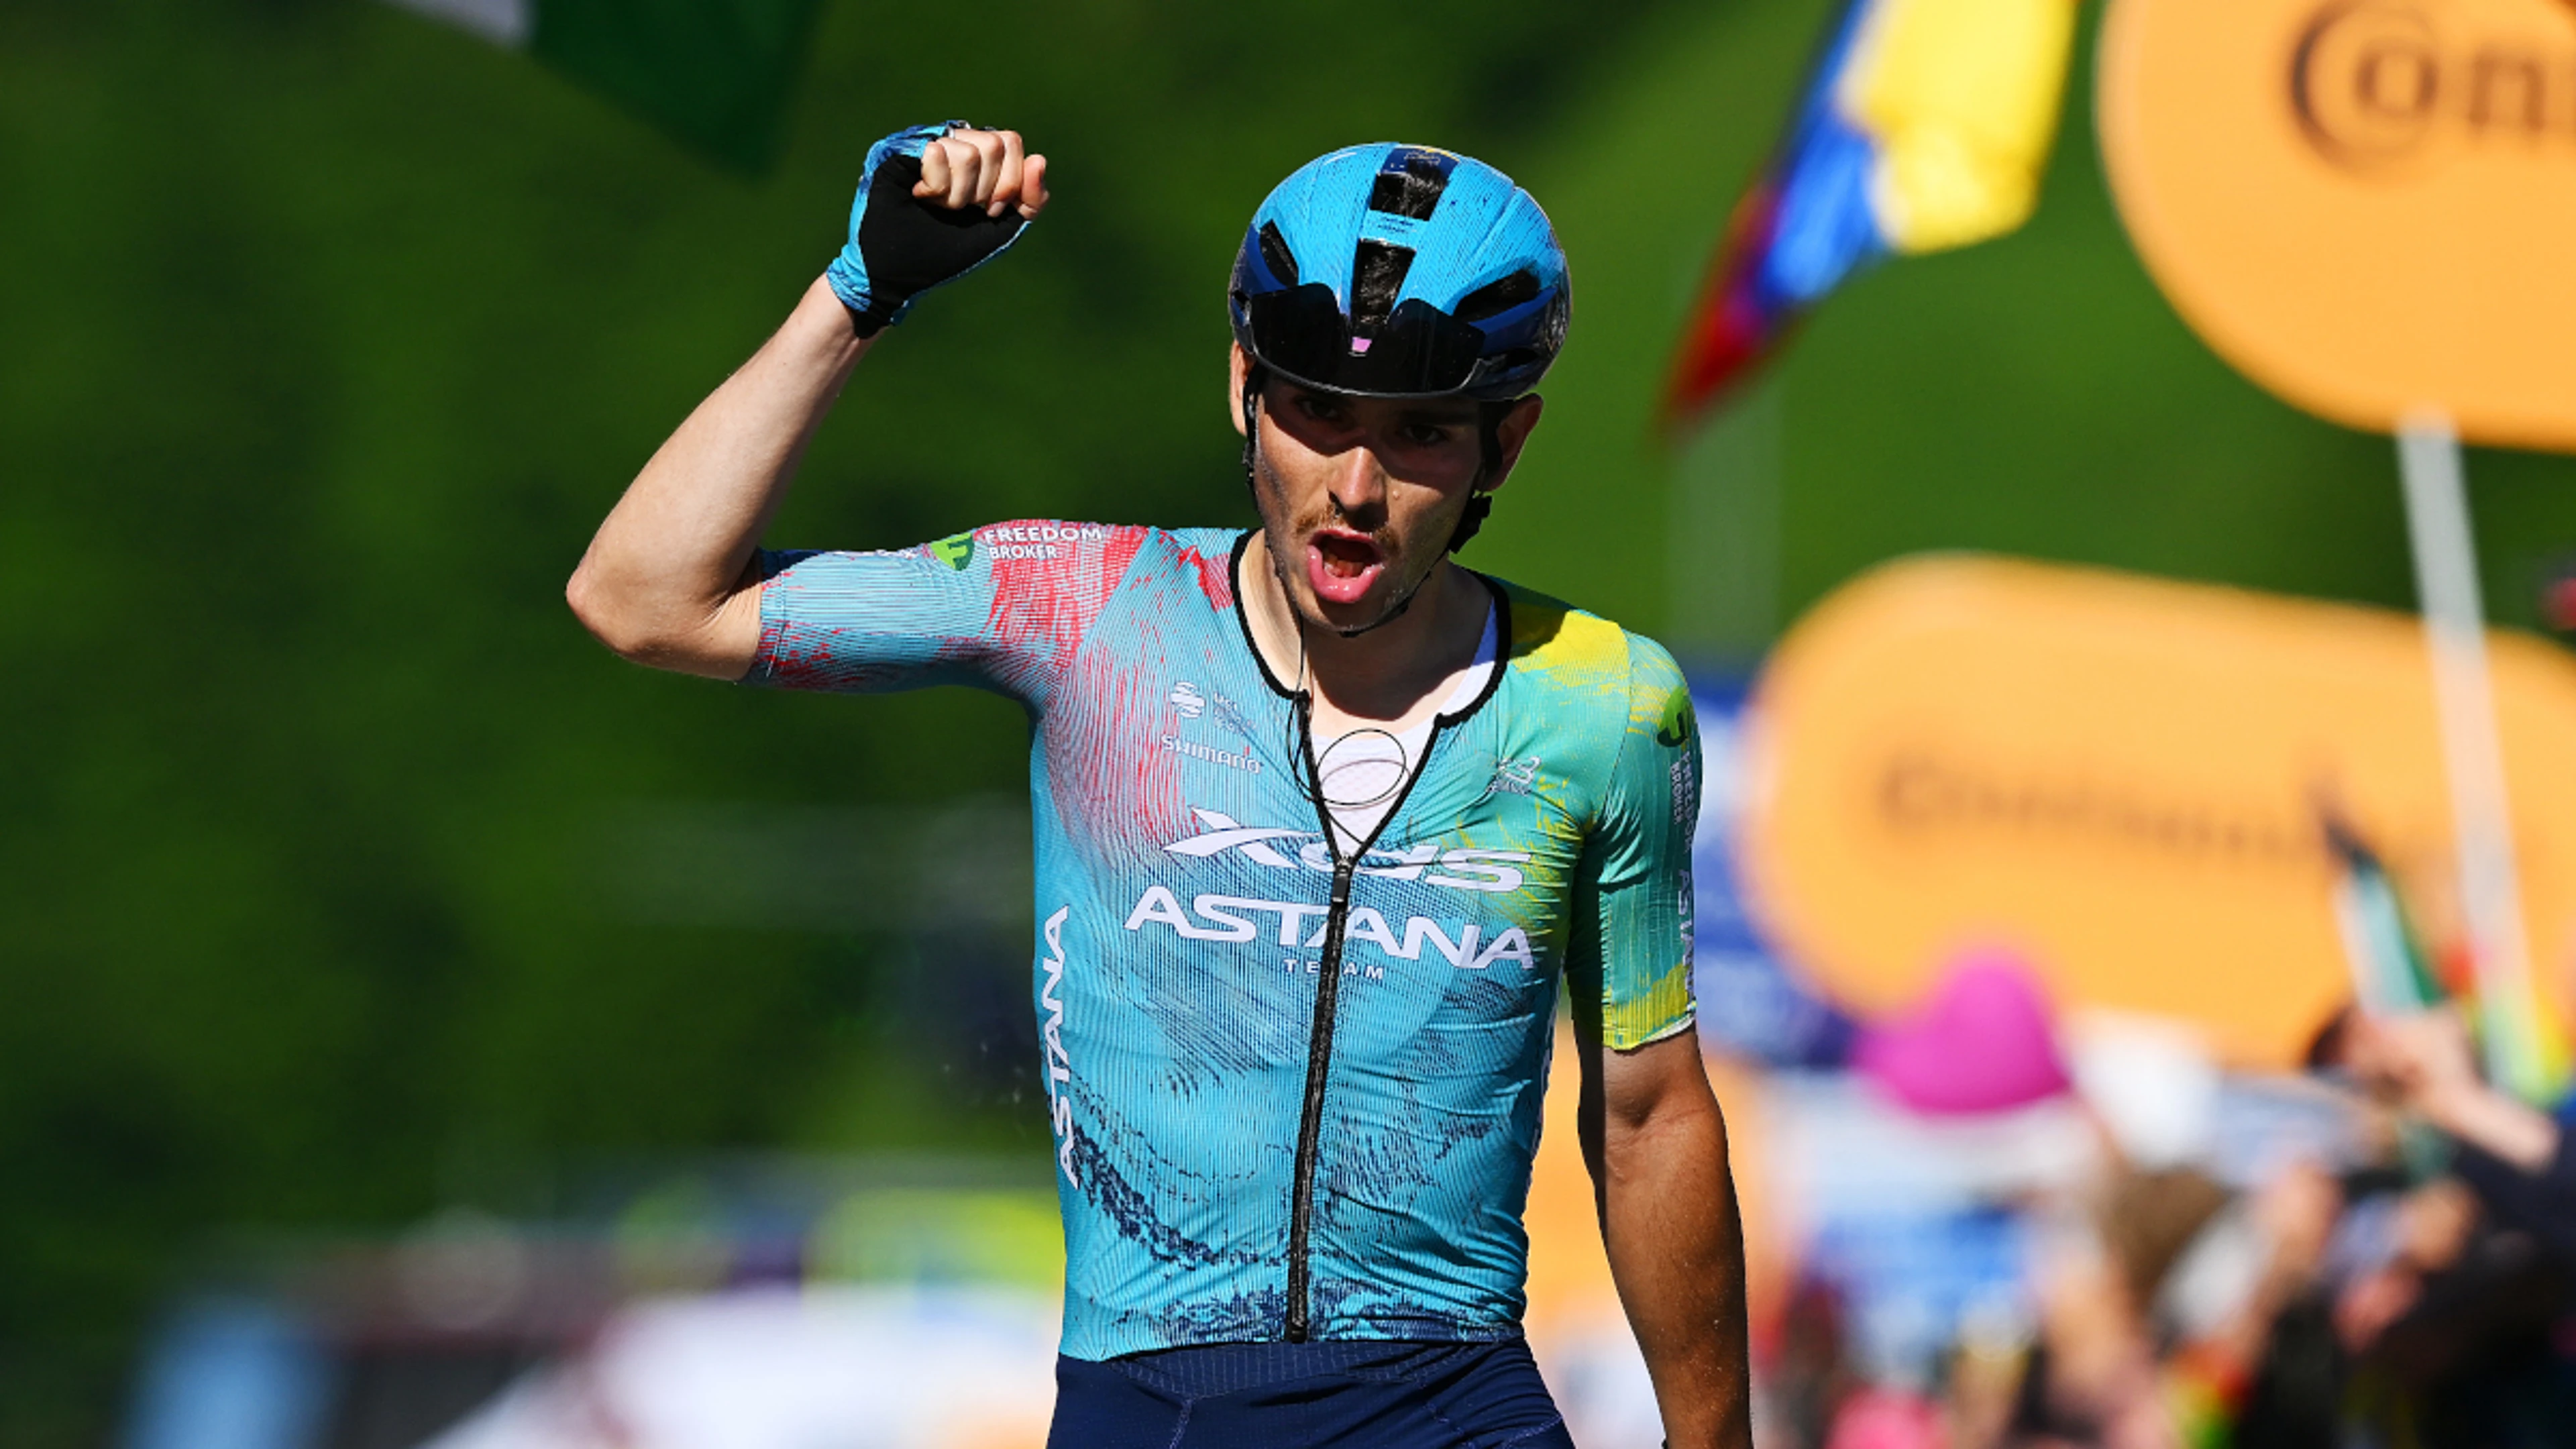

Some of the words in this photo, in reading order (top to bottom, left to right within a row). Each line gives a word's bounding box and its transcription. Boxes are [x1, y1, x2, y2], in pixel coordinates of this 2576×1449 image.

[983, 527, 1103, 544] FREEDOM
[989, 545, 1057, 560] BROKER
[1161, 734, 1260, 773] SHIMANO
[1124, 885, 1534, 970] ASTANA
[1283, 959, 1384, 980] TEAM
[1042, 904, 1080, 1191] ASTANA
